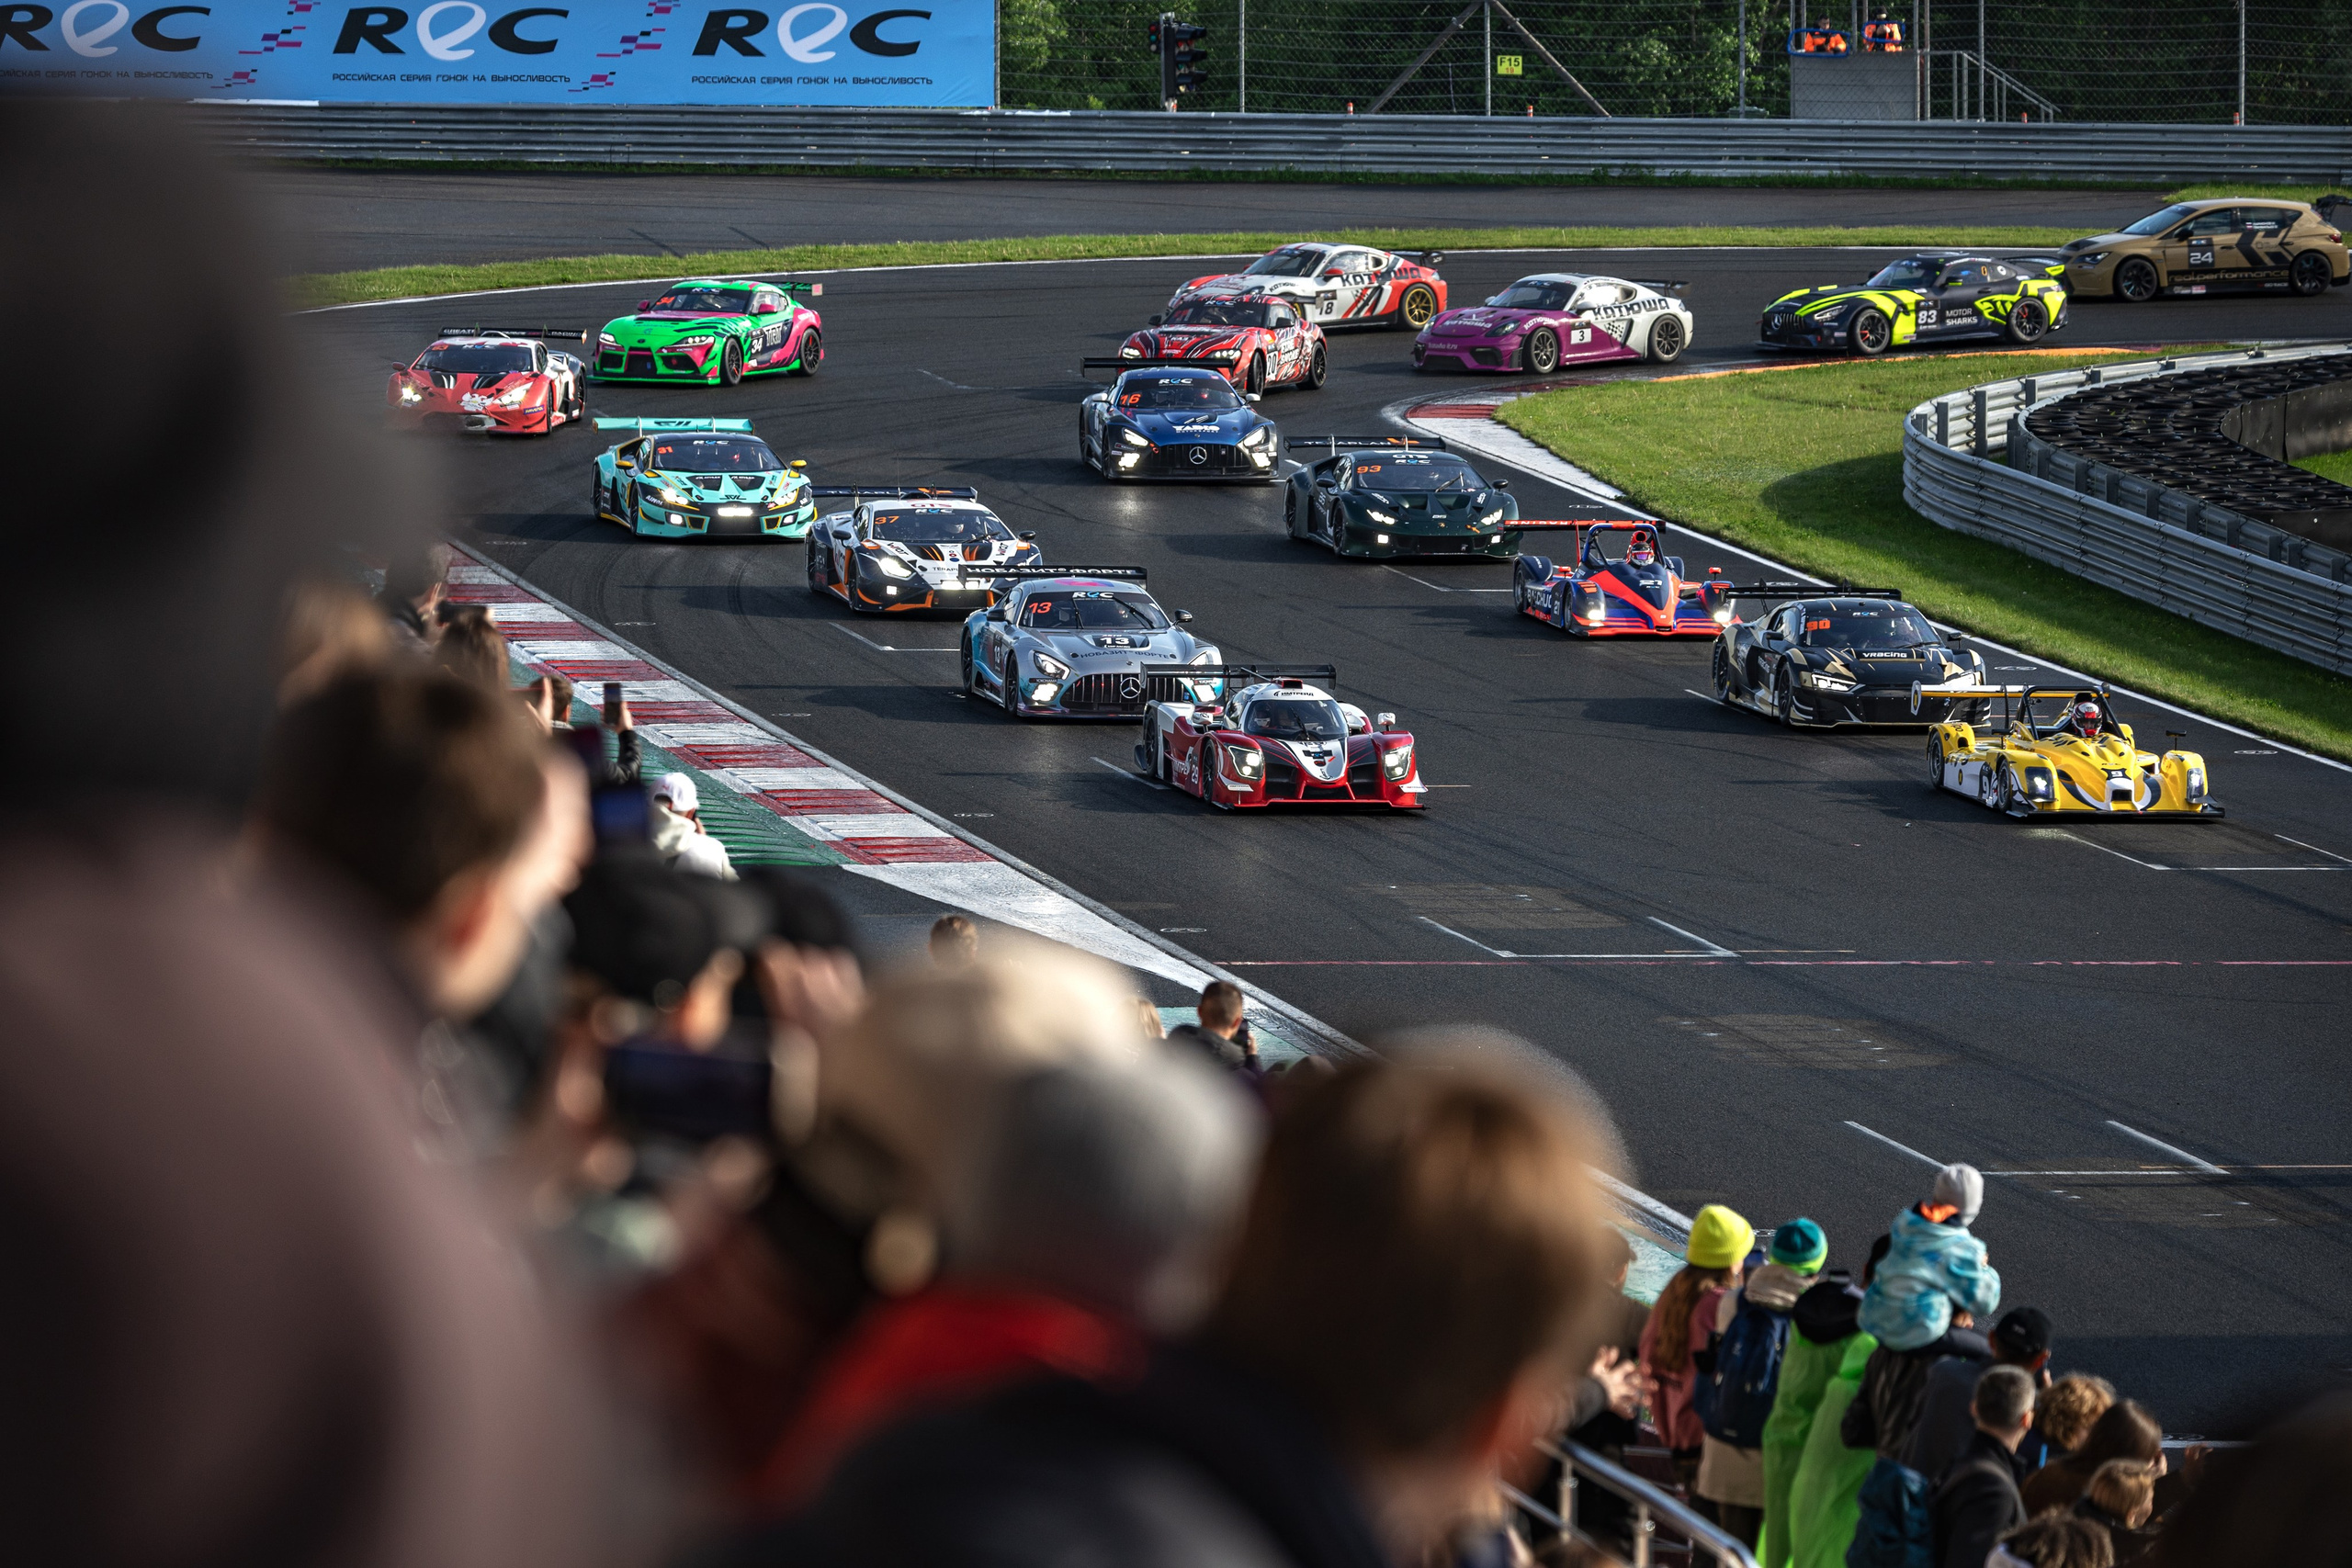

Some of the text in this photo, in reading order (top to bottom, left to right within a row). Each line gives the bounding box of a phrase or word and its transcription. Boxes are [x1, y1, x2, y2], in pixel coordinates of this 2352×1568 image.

[1499, 57, 1521, 67] F15
[46, 71, 76, 79] СЕРИЯ
[81, 71, 112, 79] ГОНОК
[117, 71, 130, 79] НА
[134, 71, 214, 80] ВЫНОСЛИВОСТЬ
[332, 72, 571, 84] РОССИЙСКАЯ СЕРИЯ ГОНОК НА ВЫНОСЛИВОСТЬ
[691, 74, 933, 86] РОССИЙСКАЯ СЕРИЯ ГОНОК НА ВЫНОСЛИВОСТЬ
[2189, 252, 2214, 265] 24
[1318, 301, 1335, 316] 18
[1946, 308, 1973, 318] MOTOR
[1917, 310, 1938, 325] 83
[1946, 316, 1978, 326] SHARKS
[1578, 330, 1585, 342] 3
[751, 337, 763, 354] 34
[1267, 353, 1277, 377] 20
[1120, 393, 1141, 406] 16
[657, 446, 673, 455] 31
[1356, 465, 1382, 474] 93
[874, 515, 900, 525] 37
[1028, 602, 1053, 615] 13
[1554, 600, 1561, 615] 21
[1806, 619, 1831, 631] 90
[1099, 637, 1130, 645] 13
[994, 645, 1001, 664] 13
[1135, 649, 1170, 660] ФОРТЕ
[1191, 764, 1199, 784] 29
[2110, 770, 2123, 778] 9
[1982, 775, 1990, 795] 9
